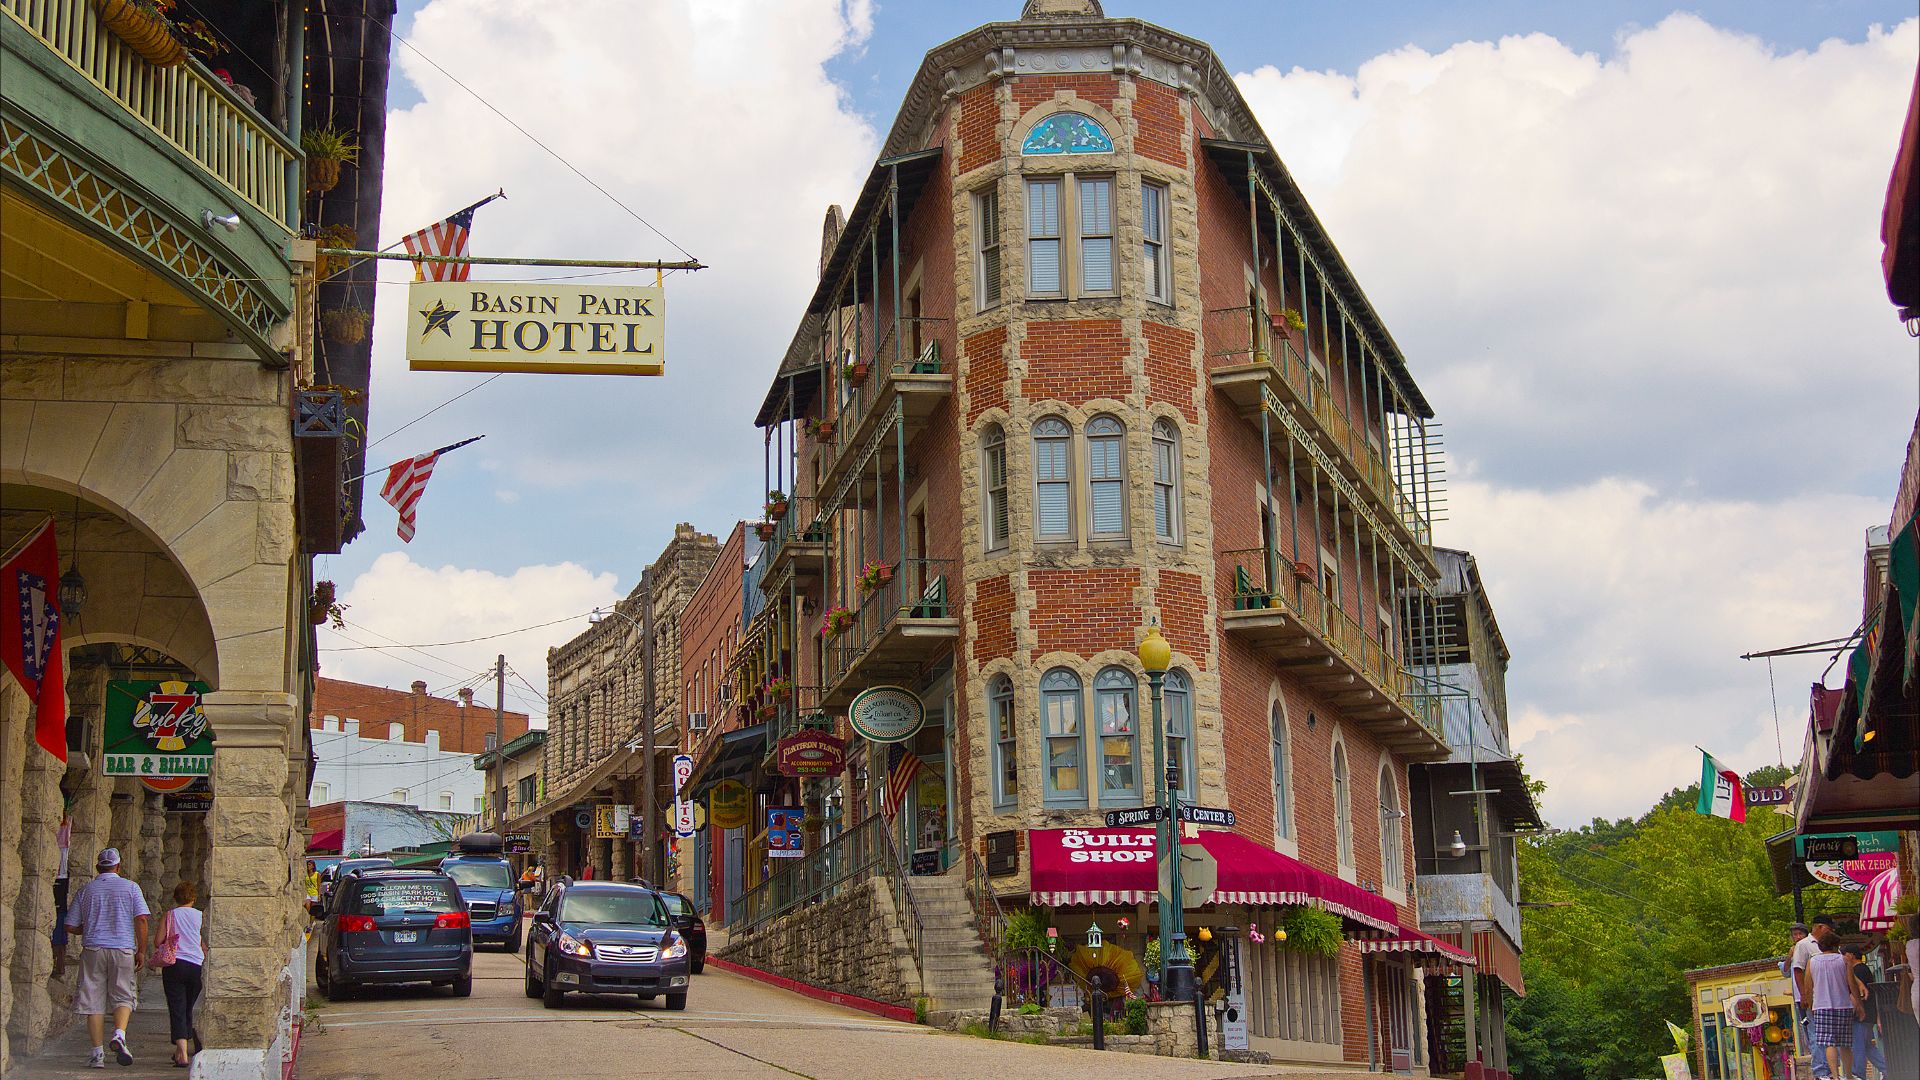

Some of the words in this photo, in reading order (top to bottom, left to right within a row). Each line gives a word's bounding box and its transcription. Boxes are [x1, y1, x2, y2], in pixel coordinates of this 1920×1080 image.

[470, 291, 559, 315] BASIN
[578, 294, 655, 317] PARK
[469, 318, 655, 356] HOTEL
[149, 691, 199, 738] 7
[862, 699, 885, 716] WILSON
[888, 699, 912, 716] WILSON
[132, 702, 207, 739] Lucky
[106, 756, 136, 773] BAR
[141, 757, 154, 774] &
[1748, 789, 1784, 802] OLD
[1118, 810, 1150, 824] SPRING
[1193, 809, 1225, 823] CENTER
[1061, 835, 1157, 848] QUILT
[1856, 834, 1880, 846] orch
[1070, 850, 1154, 863] SHOP
[1807, 840, 1840, 859] Henri's
[1845, 859, 1866, 871] PINK
